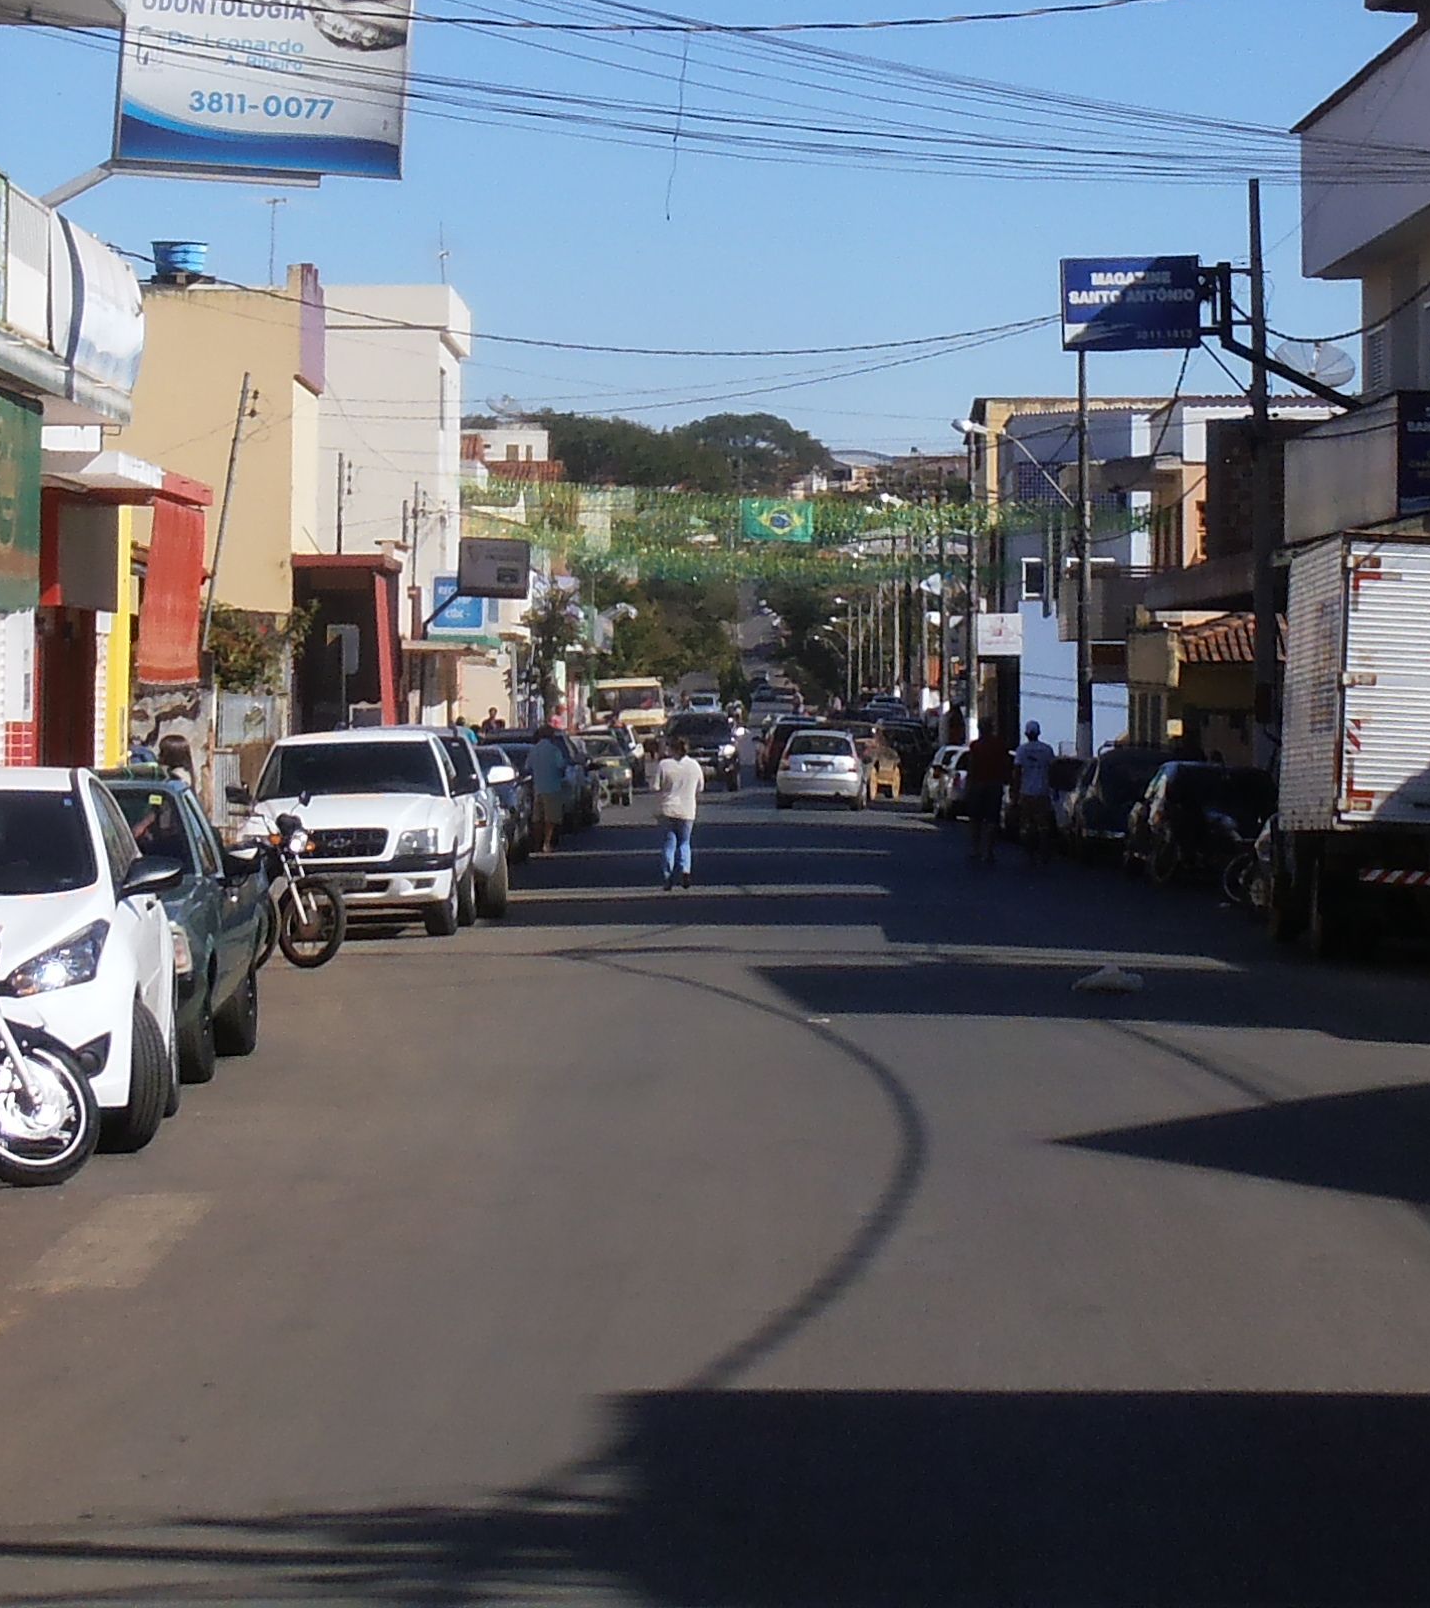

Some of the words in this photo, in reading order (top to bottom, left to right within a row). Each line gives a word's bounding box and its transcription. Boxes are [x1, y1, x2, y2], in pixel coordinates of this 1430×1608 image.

[203, 32, 305, 56] Leonardo
[188, 90, 336, 121] 3811-0077
[1090, 270, 1171, 287] MAGAZINE
[1068, 289, 1122, 305] SANTO
